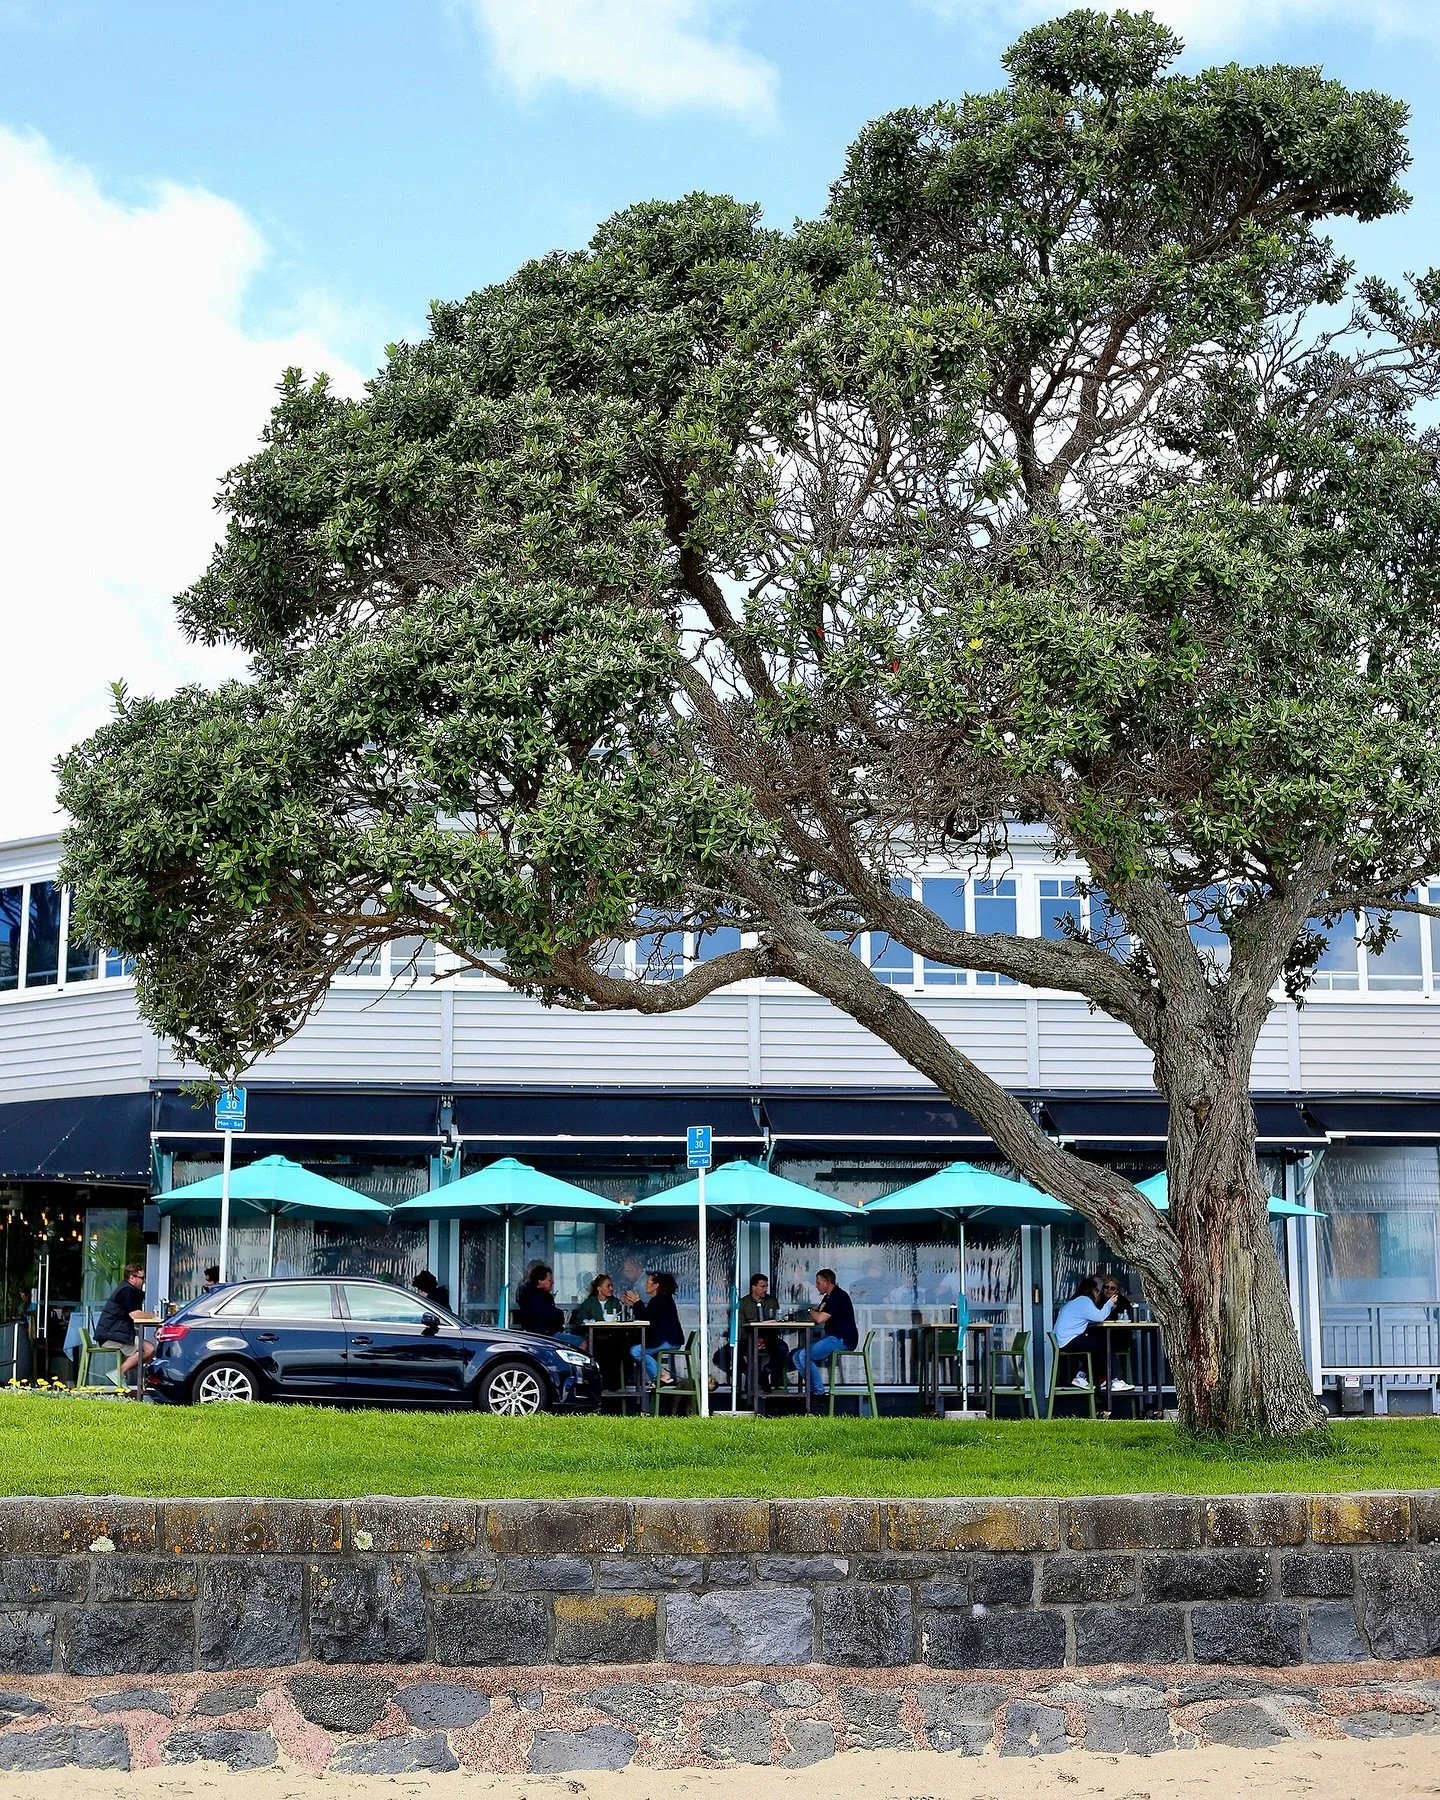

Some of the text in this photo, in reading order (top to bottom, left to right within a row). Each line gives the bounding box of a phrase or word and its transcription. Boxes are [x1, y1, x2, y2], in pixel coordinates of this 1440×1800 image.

[225, 1100, 237, 1110] 30
[696, 1128, 704, 1140] P
[694, 1140, 704, 1149] 30
